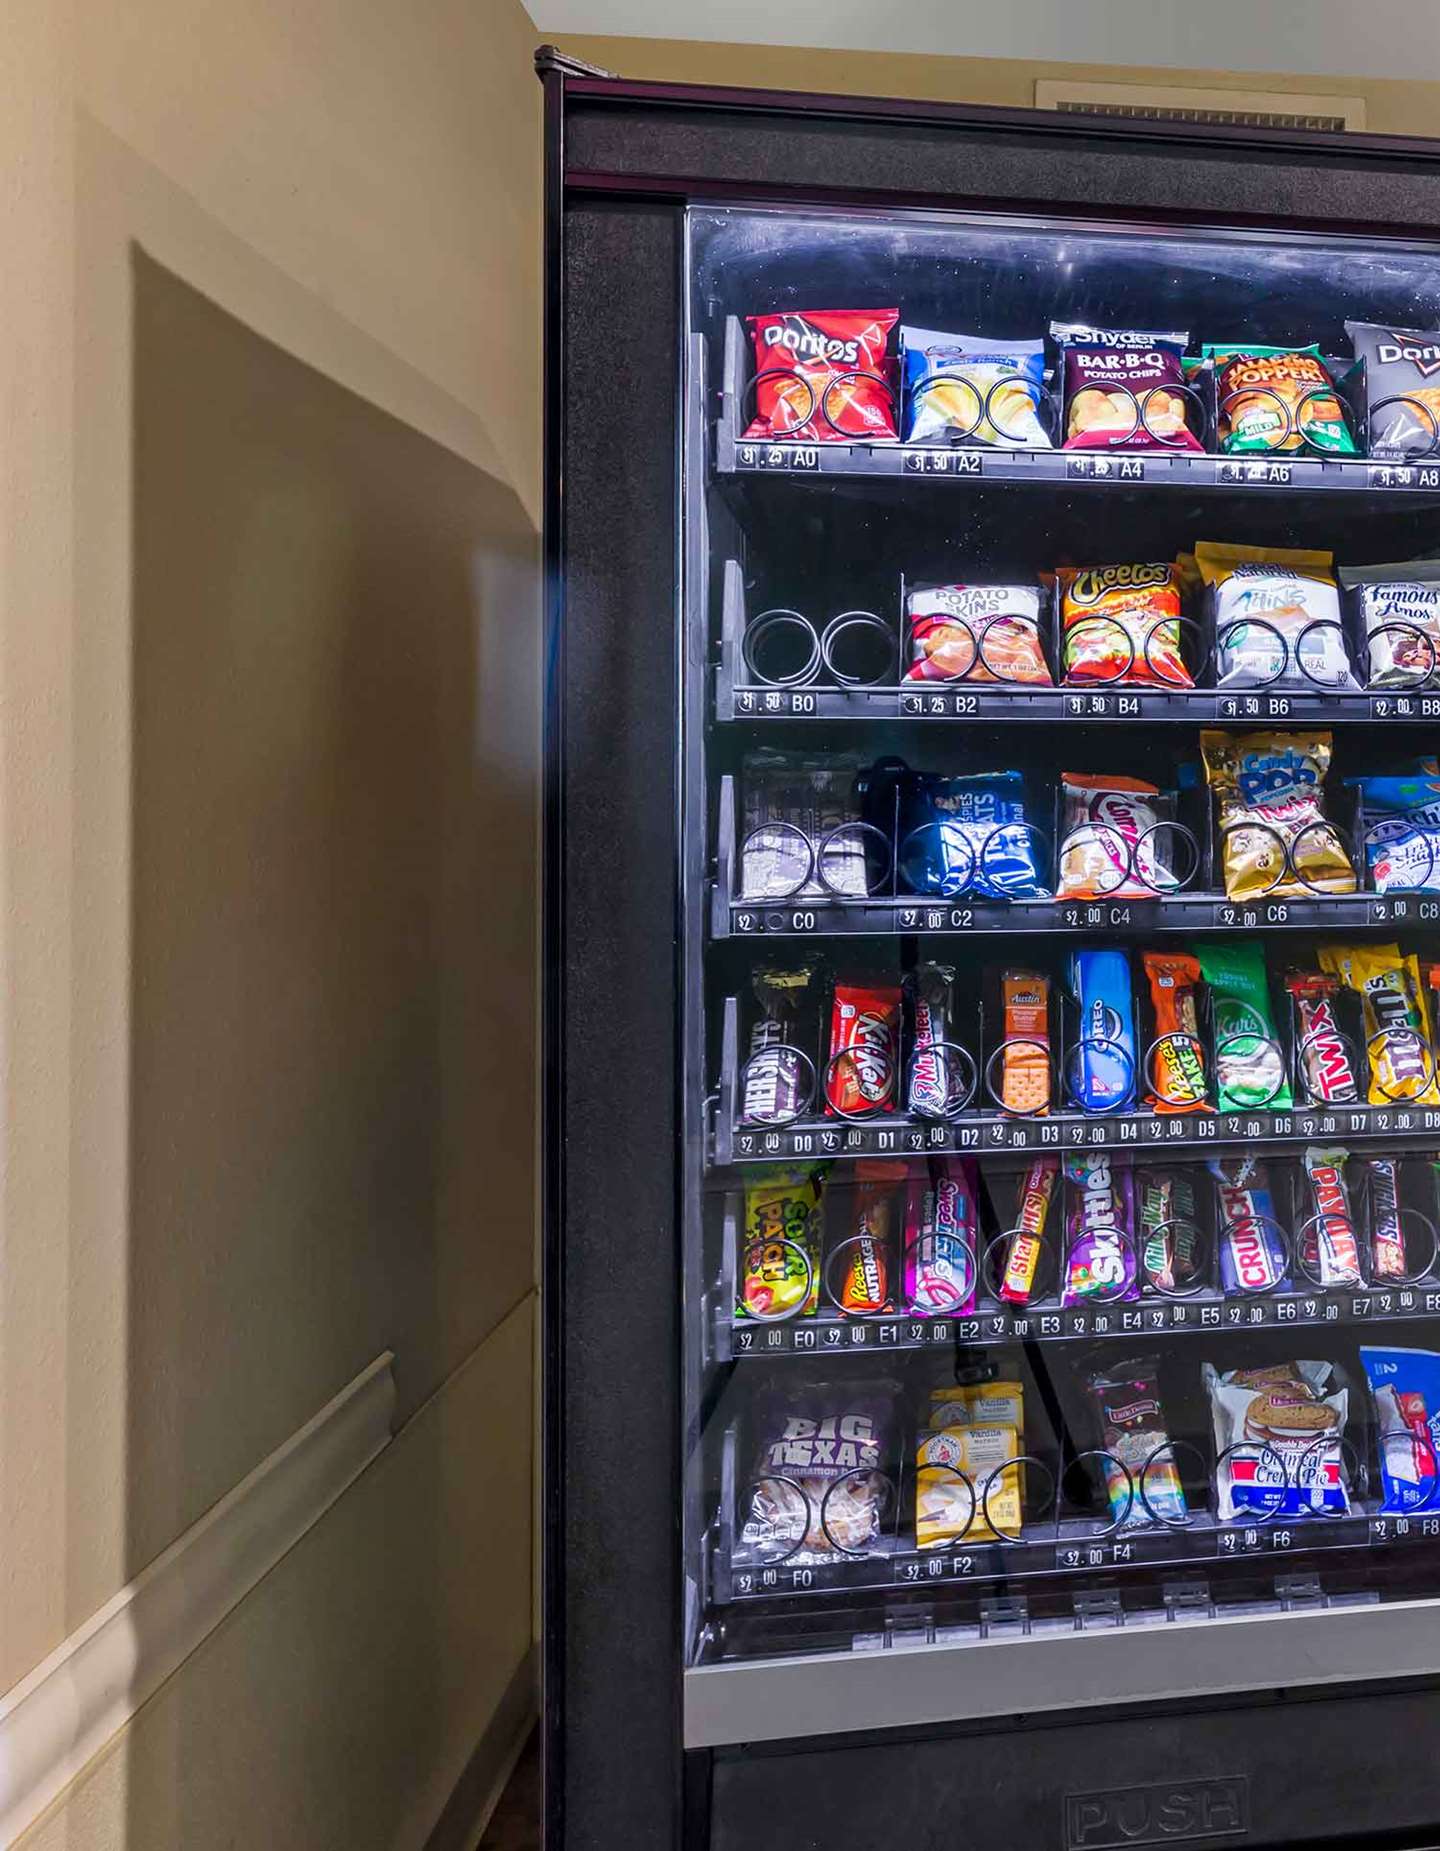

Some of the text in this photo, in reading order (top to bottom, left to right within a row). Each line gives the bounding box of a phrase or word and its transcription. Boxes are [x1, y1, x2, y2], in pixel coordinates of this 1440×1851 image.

[764, 326, 859, 363] Doritos
[1084, 369, 1162, 380] POTATO CHIPS
[793, 450, 816, 467] A0
[958, 455, 980, 472] A2
[1120, 461, 1143, 478] A4
[1269, 465, 1290, 482] A6
[1419, 470, 1439, 486] A8
[1070, 562, 1172, 606] Cheetos
[935, 589, 1009, 604] POTATO
[1370, 587, 1438, 605] Famous
[1375, 601, 1432, 619] Amos
[792, 695, 814, 711] B0
[956, 696, 977, 713] B2
[1118, 698, 1139, 714] B4
[1269, 698, 1289, 714] B6
[1422, 699, 1440, 715] B8
[951, 910, 972, 928] C2
[1111, 908, 1131, 925] C4
[1267, 905, 1288, 923] C6
[1420, 904, 1440, 920] C8
[792, 912, 814, 930] C0
[1199, 1121, 1216, 1136] D5
[1275, 1117, 1292, 1134] D6
[1351, 1114, 1367, 1131] D7
[1425, 1112, 1440, 1128] D8
[961, 1129, 978, 1145] D2
[1042, 1126, 1059, 1142] D3
[1120, 1123, 1137, 1139] D4
[794, 1136, 812, 1151] D0
[878, 1132, 895, 1148] D1
[1084, 1152, 1126, 1284] Skittles
[755, 1199, 788, 1281] PACH
[1221, 1185, 1267, 1287] CRUNCH
[860, 1214, 881, 1302] NUTRAGEOU
[1277, 1303, 1296, 1319] E6
[1353, 1299, 1371, 1315] E7
[1042, 1316, 1060, 1333] E3
[1123, 1312, 1142, 1329] E4
[1201, 1308, 1220, 1324] E5
[880, 1326, 897, 1342] E1
[960, 1322, 979, 1338] E2
[795, 1331, 815, 1347] E0
[781, 1415, 874, 1442] BIG
[768, 1440, 879, 1467] TEXAS
[781, 1466, 838, 1476] Cinnamon
[1302, 1468, 1327, 1485] Pie
[1422, 1519, 1440, 1535] F8
[1273, 1530, 1291, 1547] F6
[1113, 1543, 1131, 1560] F4
[953, 1557, 972, 1573] F2
[793, 1570, 812, 1587] F0
[1077, 1790, 1239, 1843] PUSH
